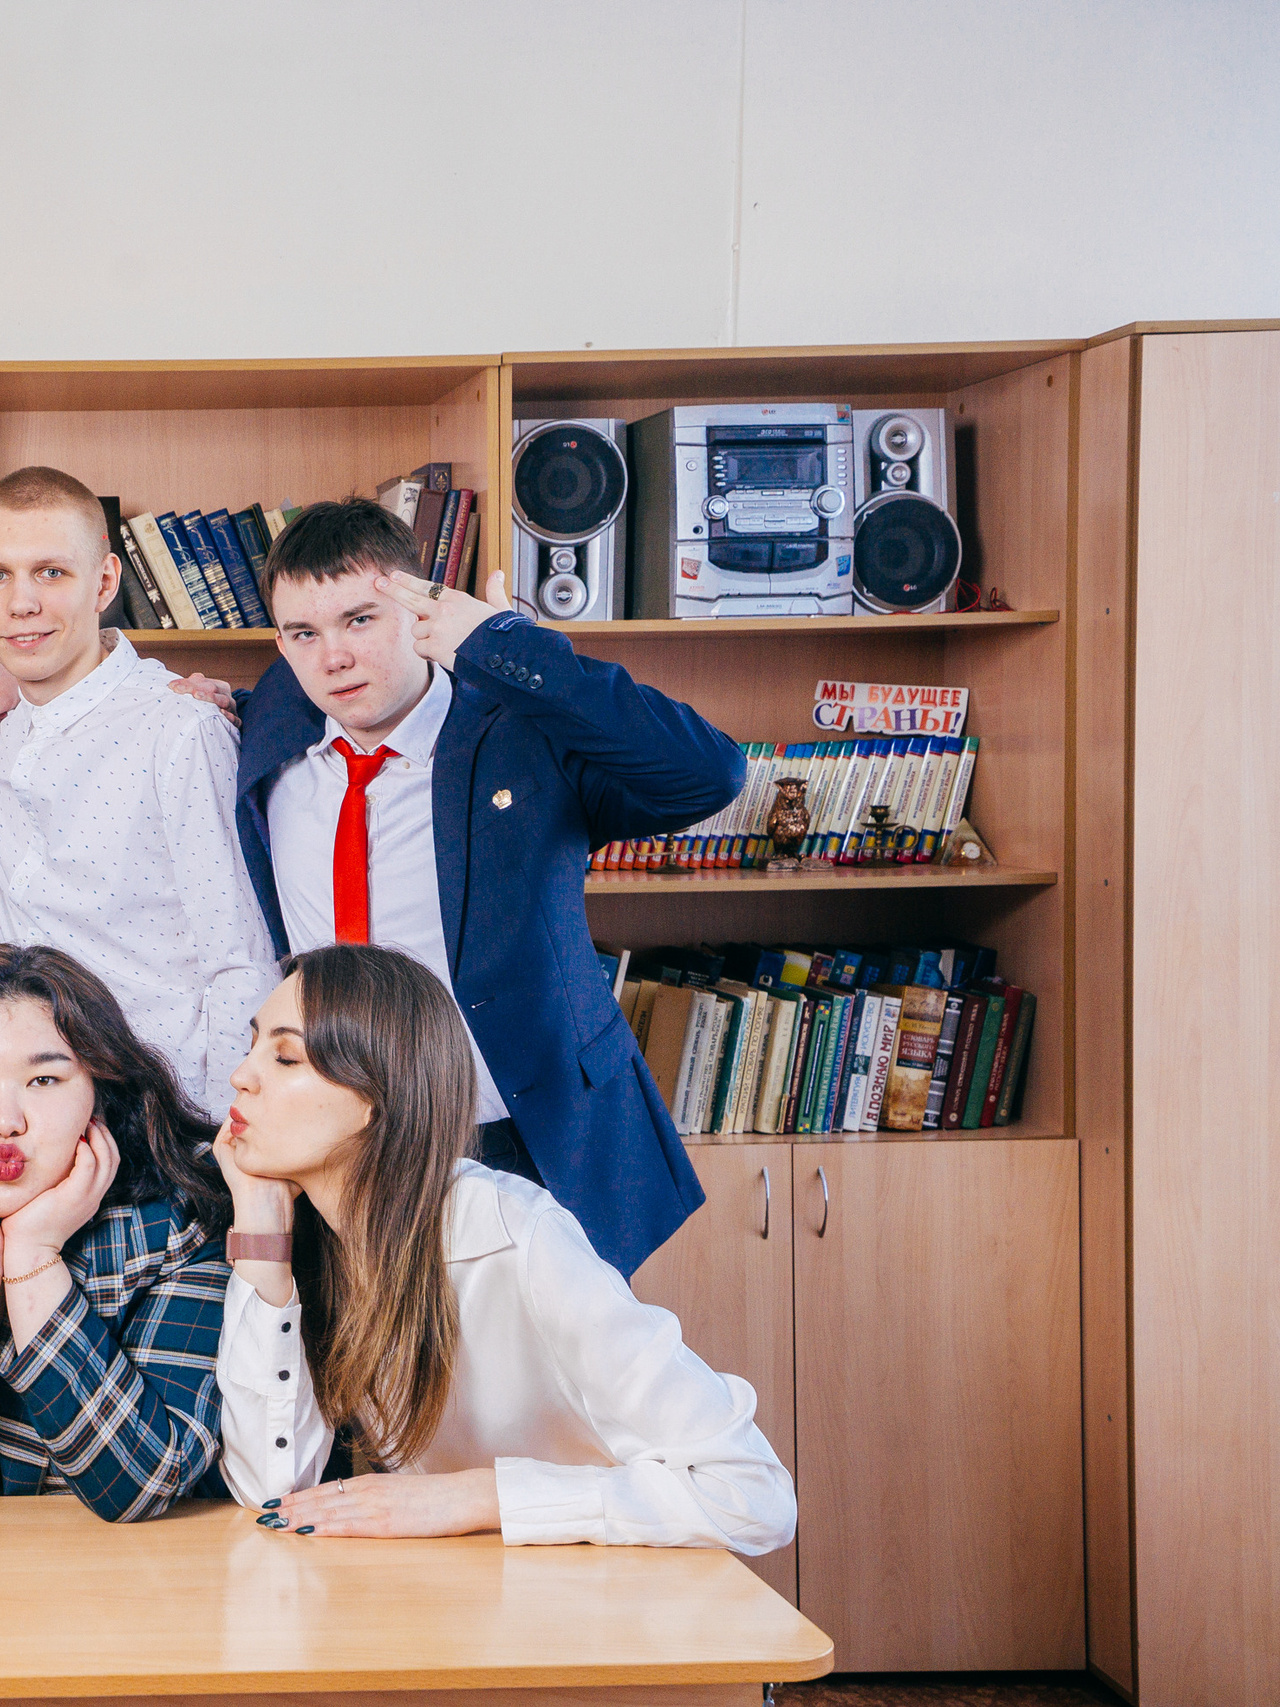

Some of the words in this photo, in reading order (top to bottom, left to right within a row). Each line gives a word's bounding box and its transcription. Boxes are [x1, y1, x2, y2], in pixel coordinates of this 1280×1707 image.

[821, 682, 855, 701] МЫ
[868, 686, 961, 708] БУДУЩЕЕ
[814, 703, 961, 734] СТРАНЫ!
[745, 807, 754, 829] СЛОВАРЬ
[751, 783, 760, 806] РУССКОГО
[757, 766, 765, 782] ЯЗЫКА
[844, 790, 854, 814] РУССКОГО
[851, 772, 859, 788] ЯЗЫКА
[863, 789, 872, 813] РУССКОГО
[870, 771, 878, 788] ЯЗЫКА
[900, 788, 910, 812] РУССКОГО
[907, 770, 915, 787] ЯЗЫКА
[919, 787, 928, 812] РУССКОГО
[938, 787, 947, 811] РУССКОГО
[944, 768, 952, 786] ЯЗЫКА
[953, 802, 961, 824] СЛОВАРЬ
[753, 1005, 763, 1033] ЛОГИКЕ
[707, 1032, 718, 1062] СЛОВАРЬ
[751, 1035, 757, 1046] ПО
[879, 1024, 895, 1052] МИР
[901, 1048, 932, 1058] ЯЗЫКА
[903, 1042, 934, 1050] РУССКОГО
[904, 1035, 935, 1044] СЛОВАРЬ
[745, 1048, 755, 1080] СЛОВАРЬ
[817, 1066, 830, 1110] ТРУДНОСТИ
[824, 1028, 836, 1064] РУССКОГО
[830, 1004, 841, 1029] ЯЗЫКА
[848, 1075, 861, 1118] ЛИТЕРАТУРА
[860, 1001, 875, 1049] ИСКУССТВО
[680, 1089, 689, 1123] ШКОЛЬНЫЙ
[685, 1056, 695, 1088] ТОЛКОВЫЙ
[692, 1029, 700, 1054] СЛОВАРЬ
[870, 1055, 888, 1110] ПОЗНАЮ
[739, 1082, 749, 1114] КРАТКИЙ
[867, 1111, 879, 1122] Я
